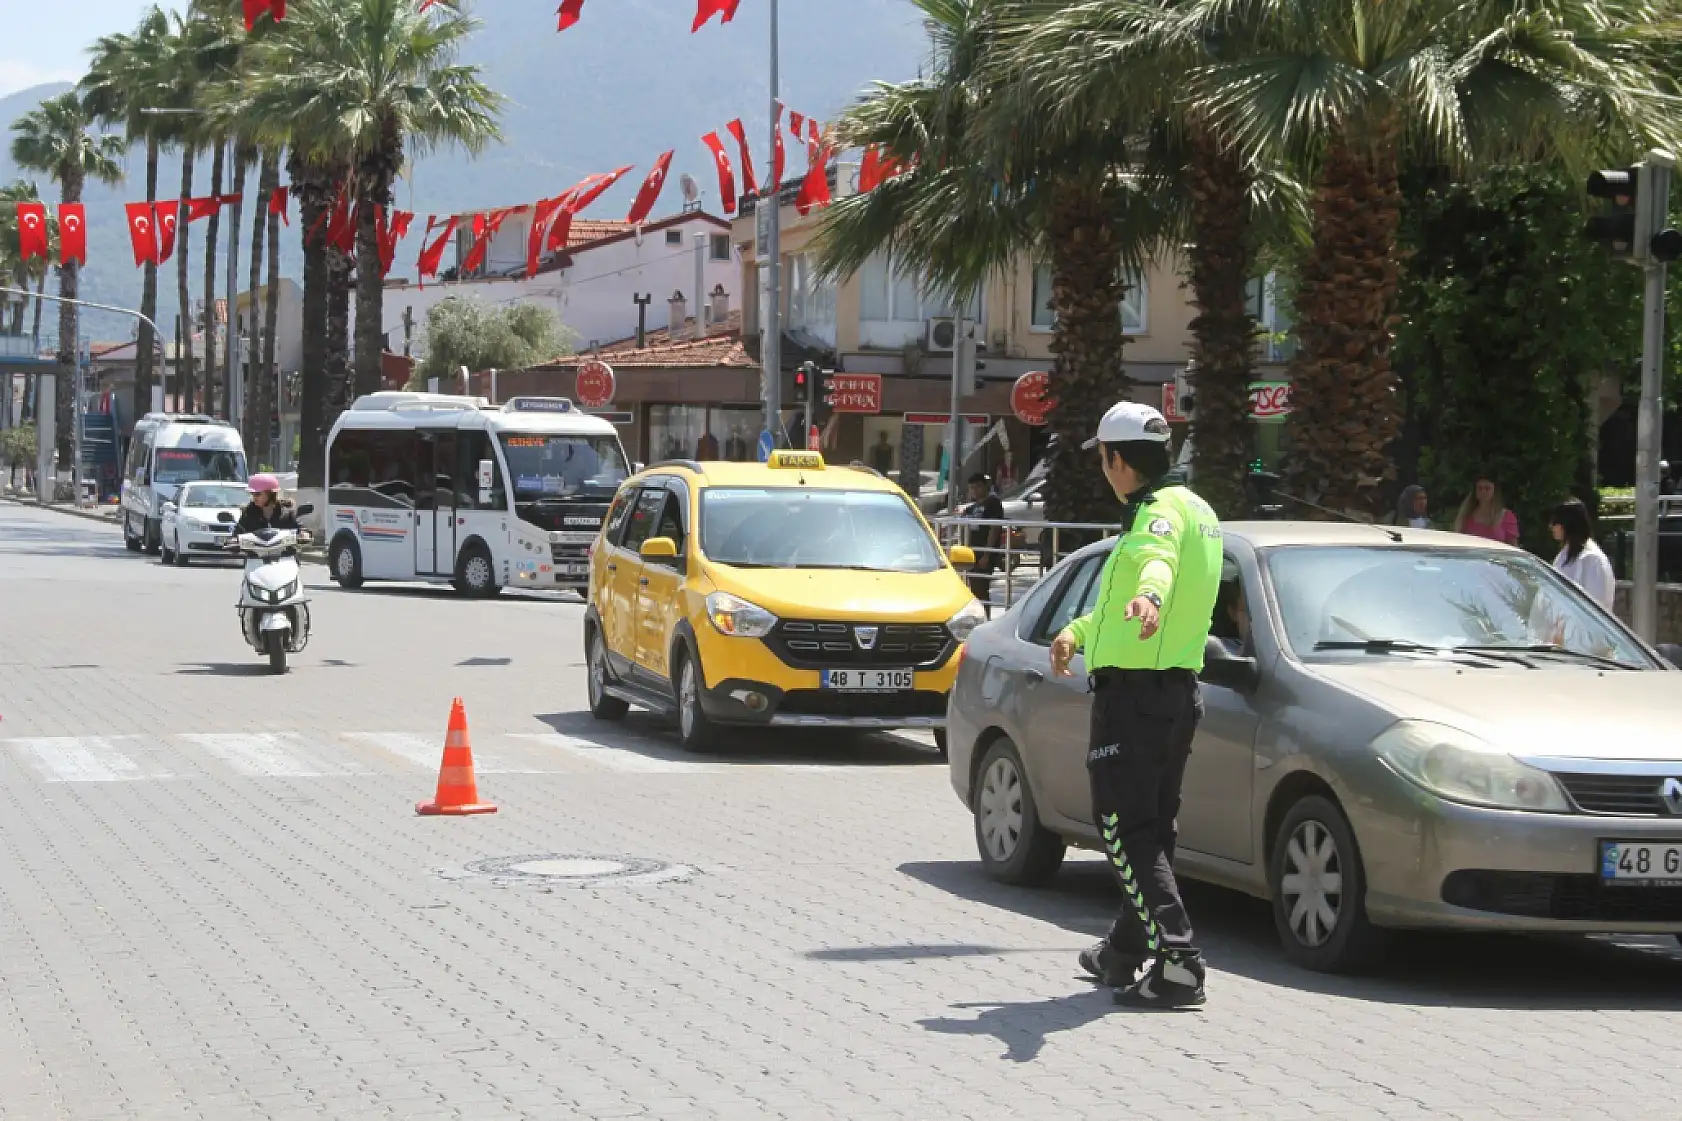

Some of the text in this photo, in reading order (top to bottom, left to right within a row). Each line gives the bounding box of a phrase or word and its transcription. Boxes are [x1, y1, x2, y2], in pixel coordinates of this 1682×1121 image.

[830, 671, 912, 687] 48 T 3105
[1619, 847, 1680, 874] 48 G
